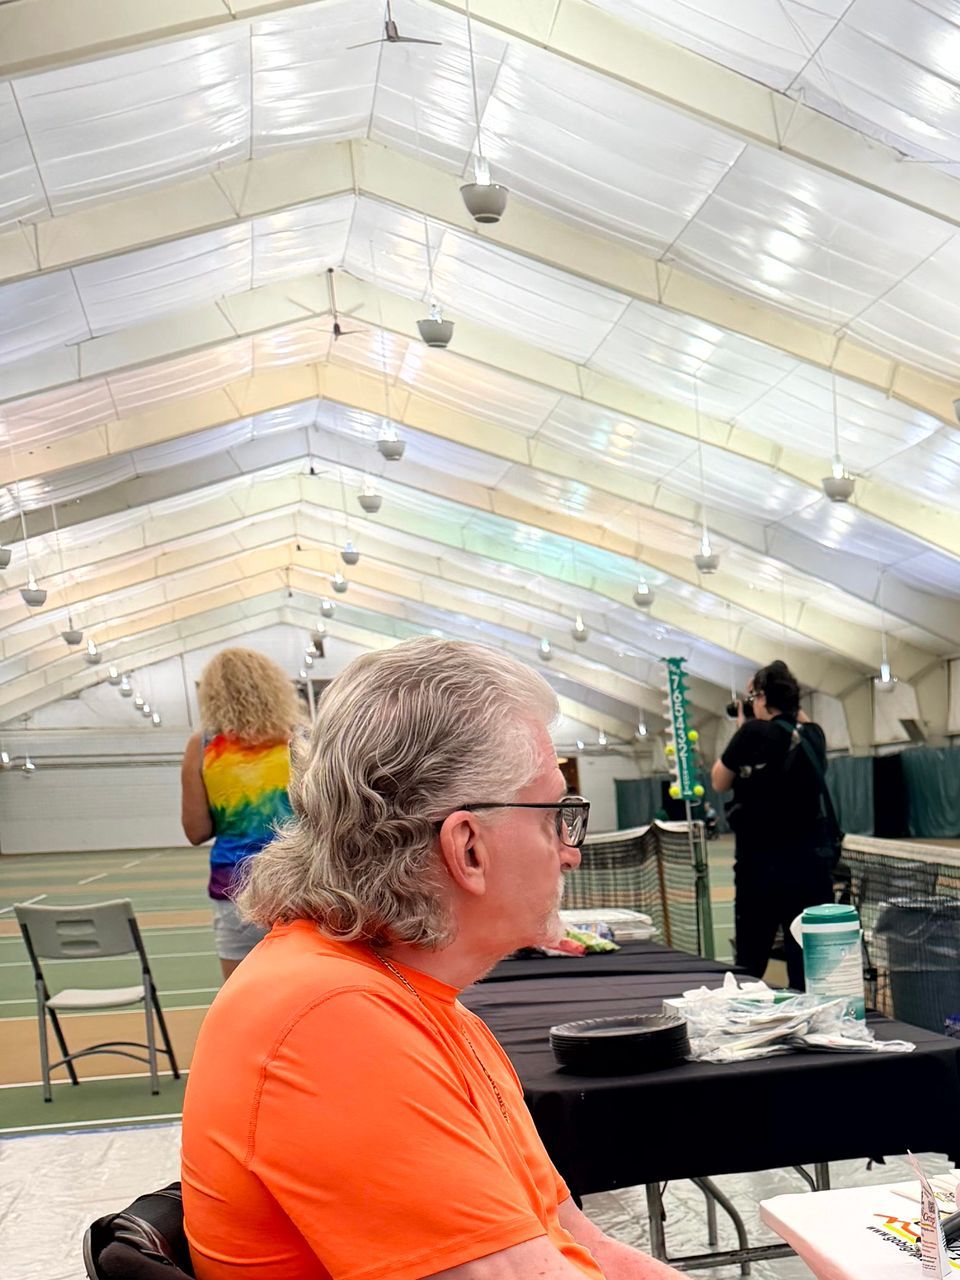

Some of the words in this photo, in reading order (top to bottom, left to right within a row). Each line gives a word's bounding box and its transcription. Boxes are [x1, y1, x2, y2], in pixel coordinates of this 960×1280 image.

[671, 675, 679, 689] 7
[672, 689, 682, 702] 6
[674, 703, 684, 716] 5
[678, 730, 686, 744] 3
[680, 744, 688, 757] 2
